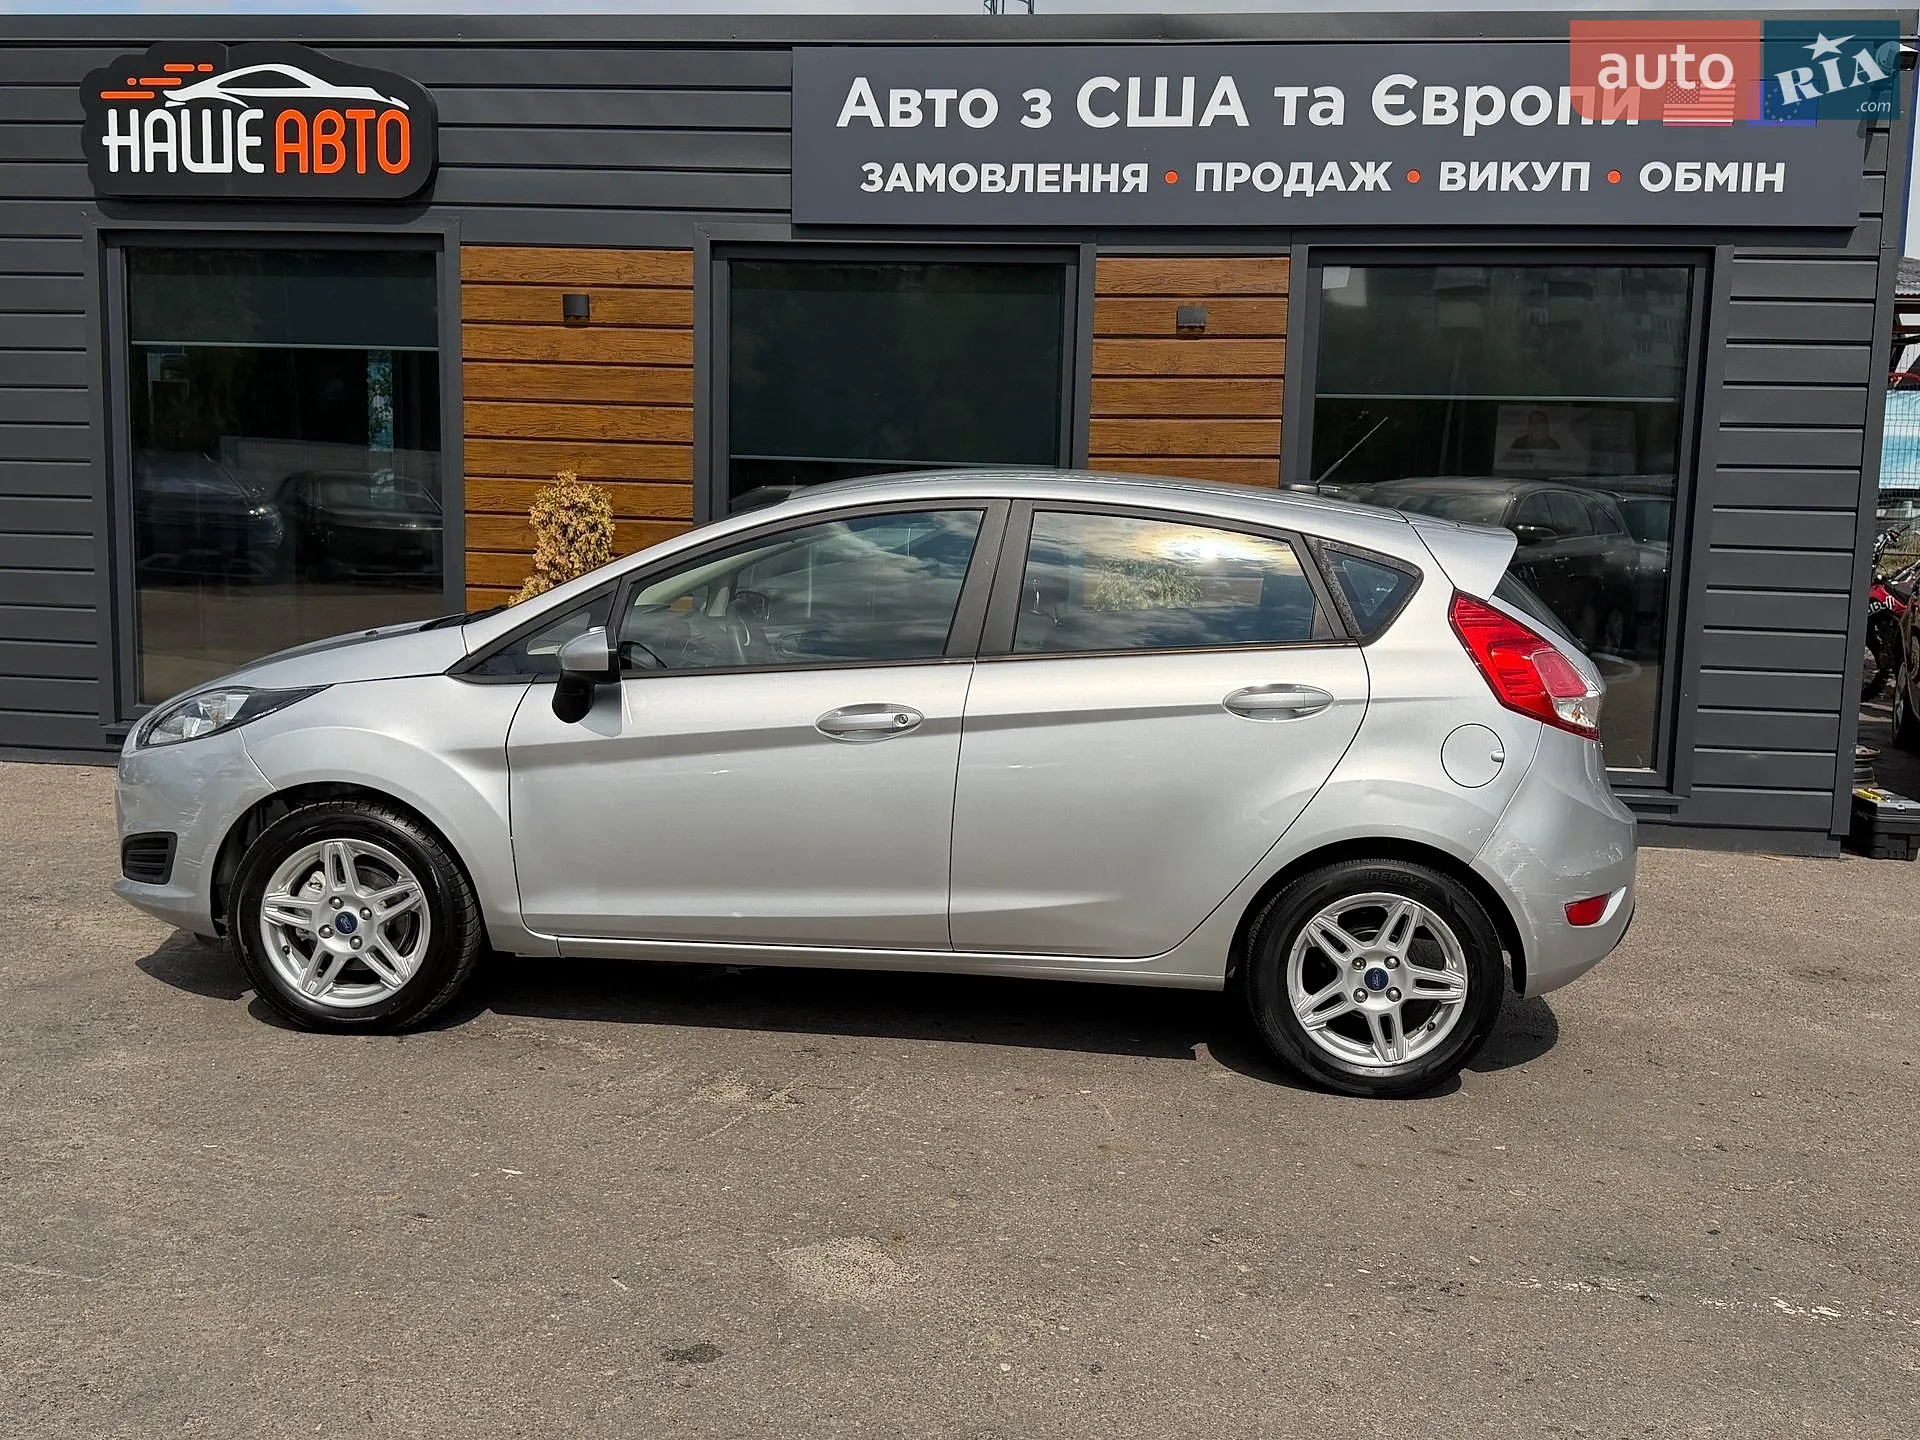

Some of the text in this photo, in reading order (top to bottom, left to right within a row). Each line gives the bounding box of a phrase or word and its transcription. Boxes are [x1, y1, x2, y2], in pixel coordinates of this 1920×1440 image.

[835, 73, 1640, 137] Авто з США та Європи
[102, 108, 411, 175] НАШЕ АВТО
[860, 161, 1787, 198] ЗАМОВЛЕННЯ ПРОДАЖ ВИКУП ОБМІН
